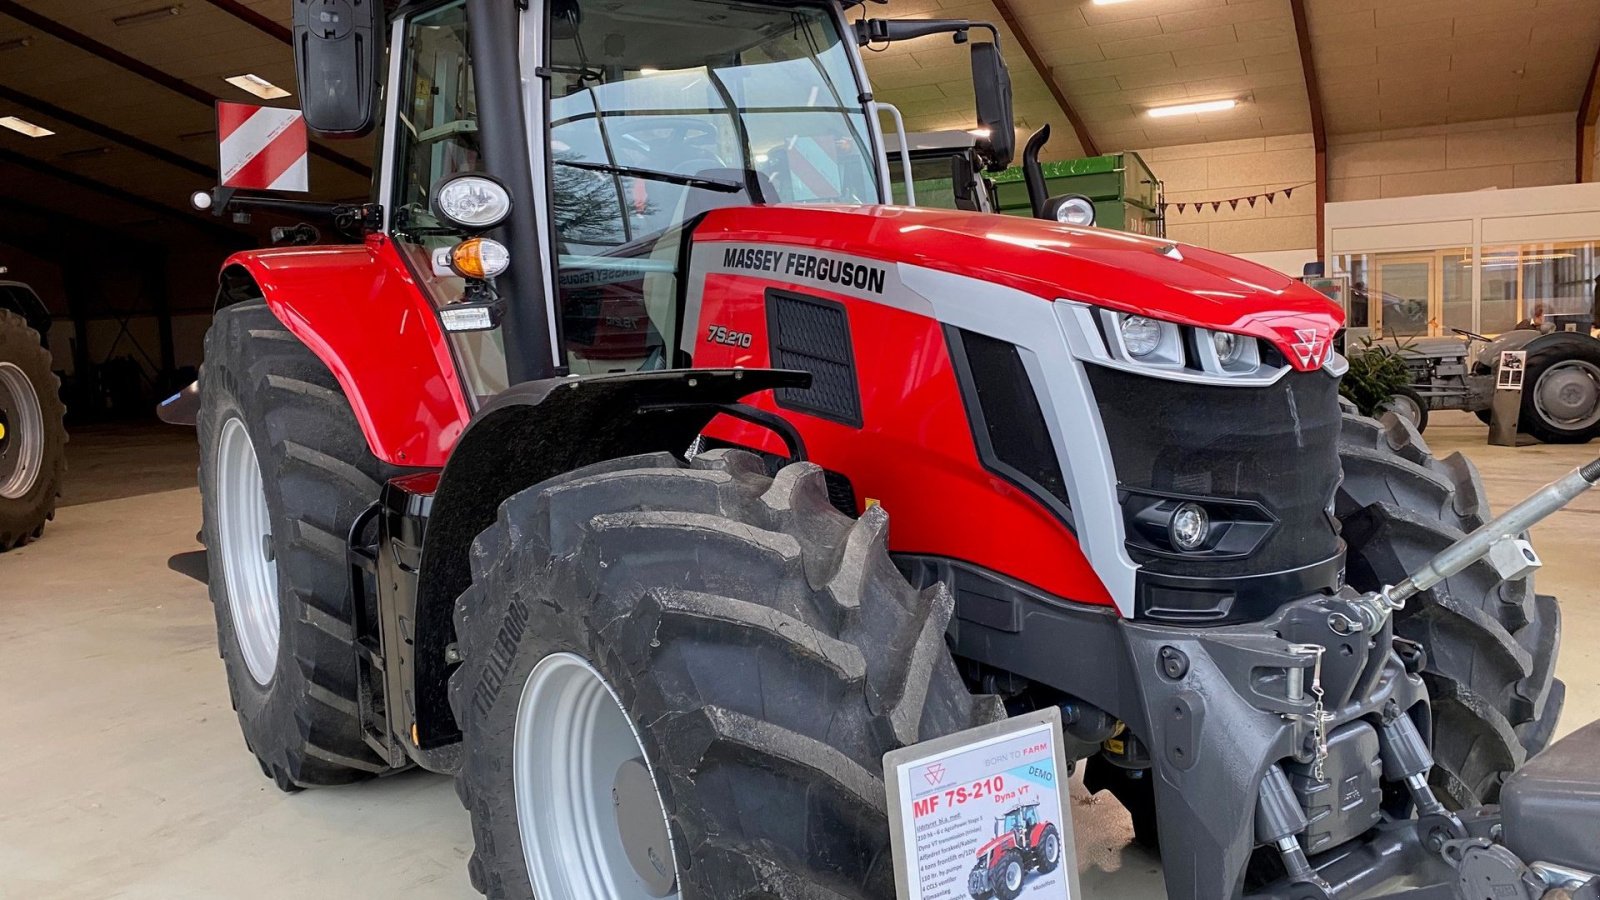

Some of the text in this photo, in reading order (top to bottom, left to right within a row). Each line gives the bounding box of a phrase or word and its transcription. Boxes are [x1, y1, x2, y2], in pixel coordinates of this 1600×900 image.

[723, 248, 886, 294] MASSEY FERGUSON
[707, 325, 752, 349] 7S.210
[471, 591, 529, 720] TRELLEBORG
[985, 743, 1047, 767] BORN TO FARM
[1029, 766, 1053, 781] DEMO
[914, 795, 939, 818] MF
[945, 775, 1004, 807] 7S-210
[994, 785, 1030, 803] Dyna VT
